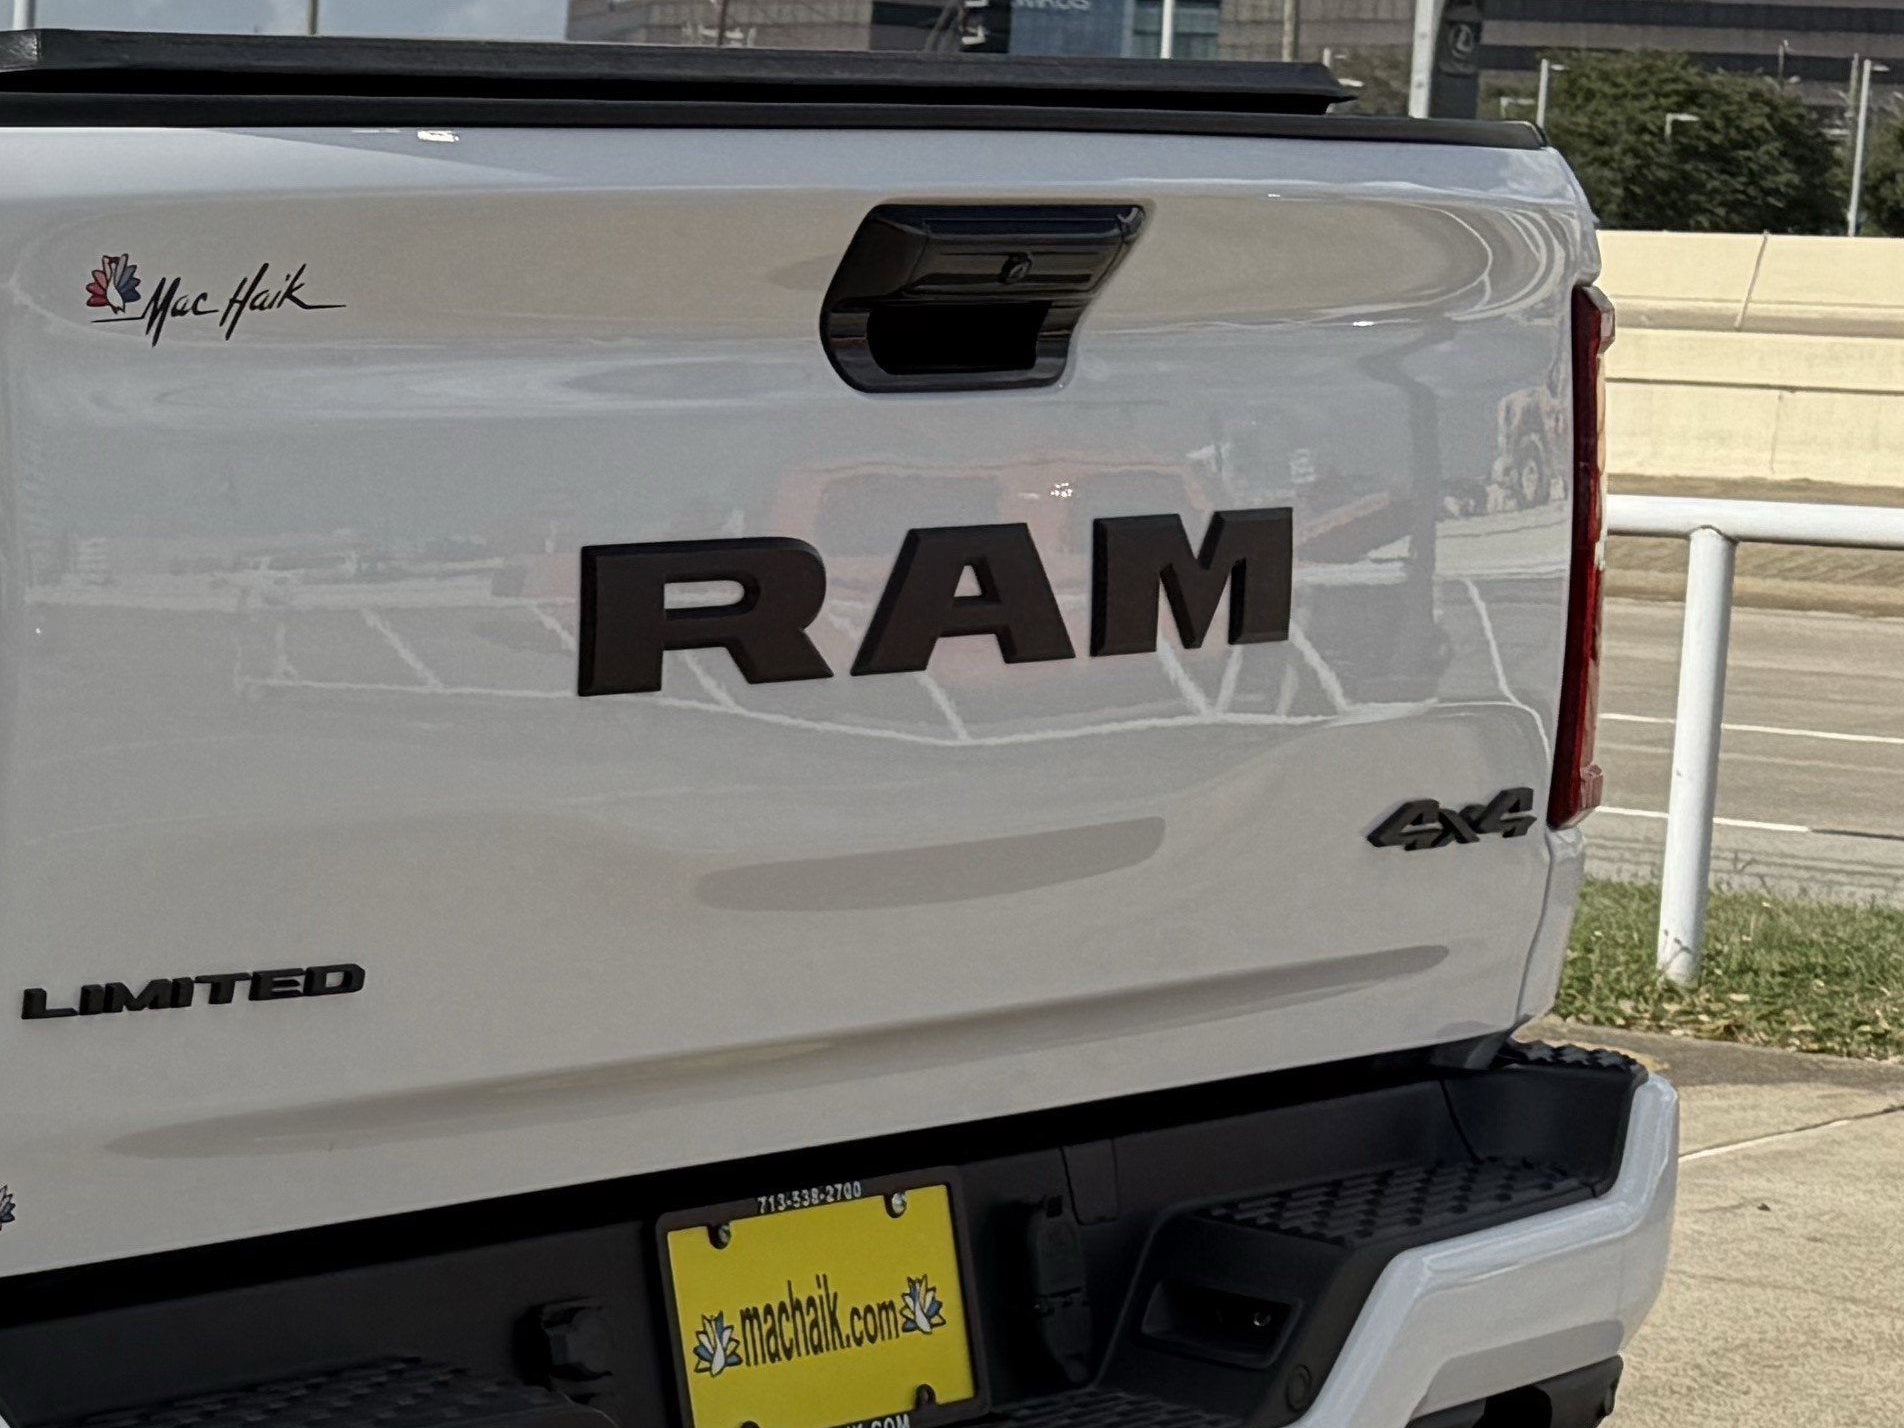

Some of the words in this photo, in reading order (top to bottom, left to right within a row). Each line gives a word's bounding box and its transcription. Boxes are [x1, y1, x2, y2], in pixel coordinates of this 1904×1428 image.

[92, 276, 219, 347] Mac
[219, 263, 346, 341] Haik
[578, 506, 1293, 697] RAM
[21, 963, 366, 1020] LIMITED
[740, 1274, 900, 1367] machaik.com
